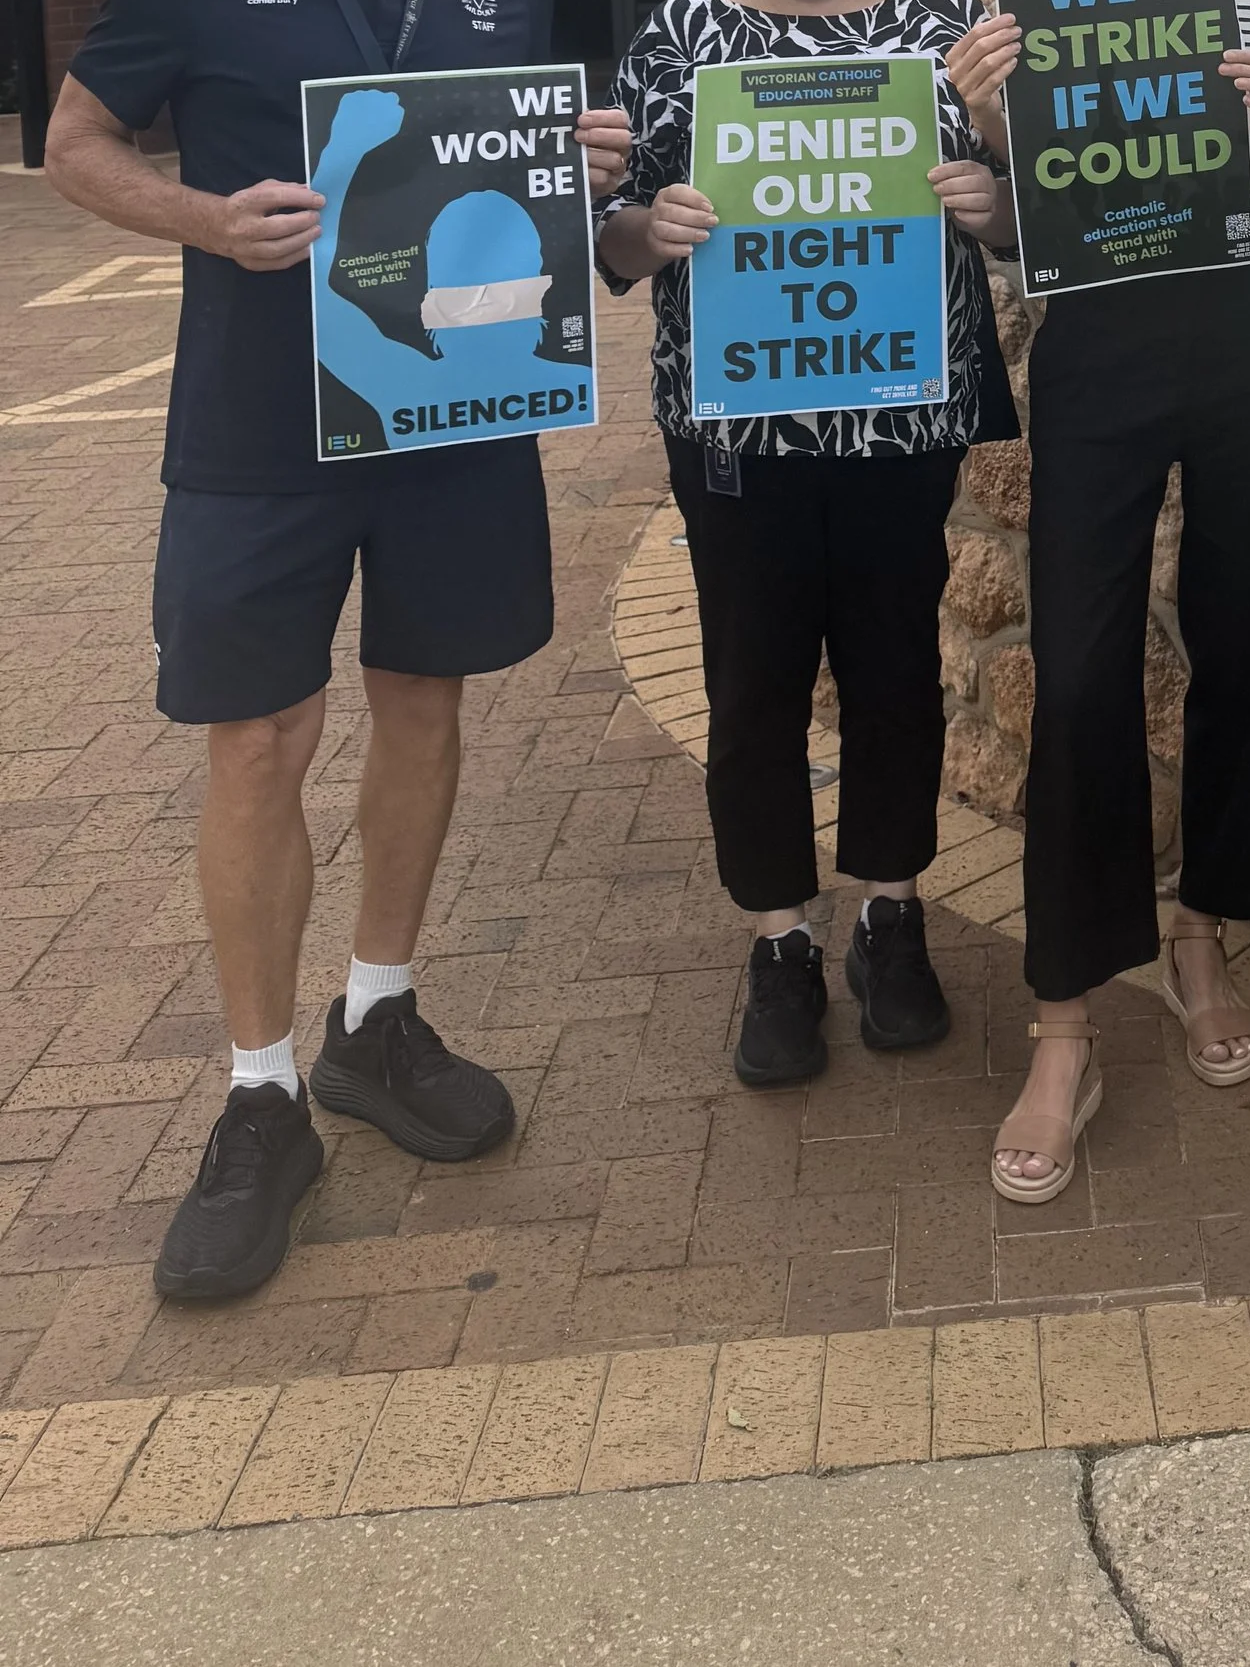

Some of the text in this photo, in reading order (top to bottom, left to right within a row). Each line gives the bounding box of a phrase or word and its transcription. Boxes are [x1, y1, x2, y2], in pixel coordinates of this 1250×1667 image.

[472, 20, 496, 32] STAFF
[1025, 9, 1224, 72] STRIKE
[746, 69, 883, 86] VICTORIAN CATHOLIC
[509, 85, 573, 117] WE
[759, 86, 874, 102] EDUCATION STAFF
[1053, 70, 1206, 130] IF WE
[431, 126, 573, 165] WON'T
[716, 116, 917, 164] DENIED
[1035, 129, 1232, 190] COULD
[528, 166, 575, 198] BE
[752, 172, 873, 217] OUR
[1083, 208, 1193, 243] education staff
[1104, 200, 1167, 223] Catholic
[338, 245, 419, 268] Catholic staff
[734, 224, 905, 273] RIGHT
[1101, 227, 1178, 254] stand with
[1113, 244, 1173, 266] the AEU.
[348, 260, 411, 278] stand with
[357, 272, 407, 288] the AEU.
[1034, 268, 1060, 283] IEU
[781, 280, 858, 323] TO
[723, 330, 916, 383] STRIKE
[392, 384, 588, 435] SILENCED!
[699, 402, 725, 414] IEU
[327, 433, 361, 451] IEU
